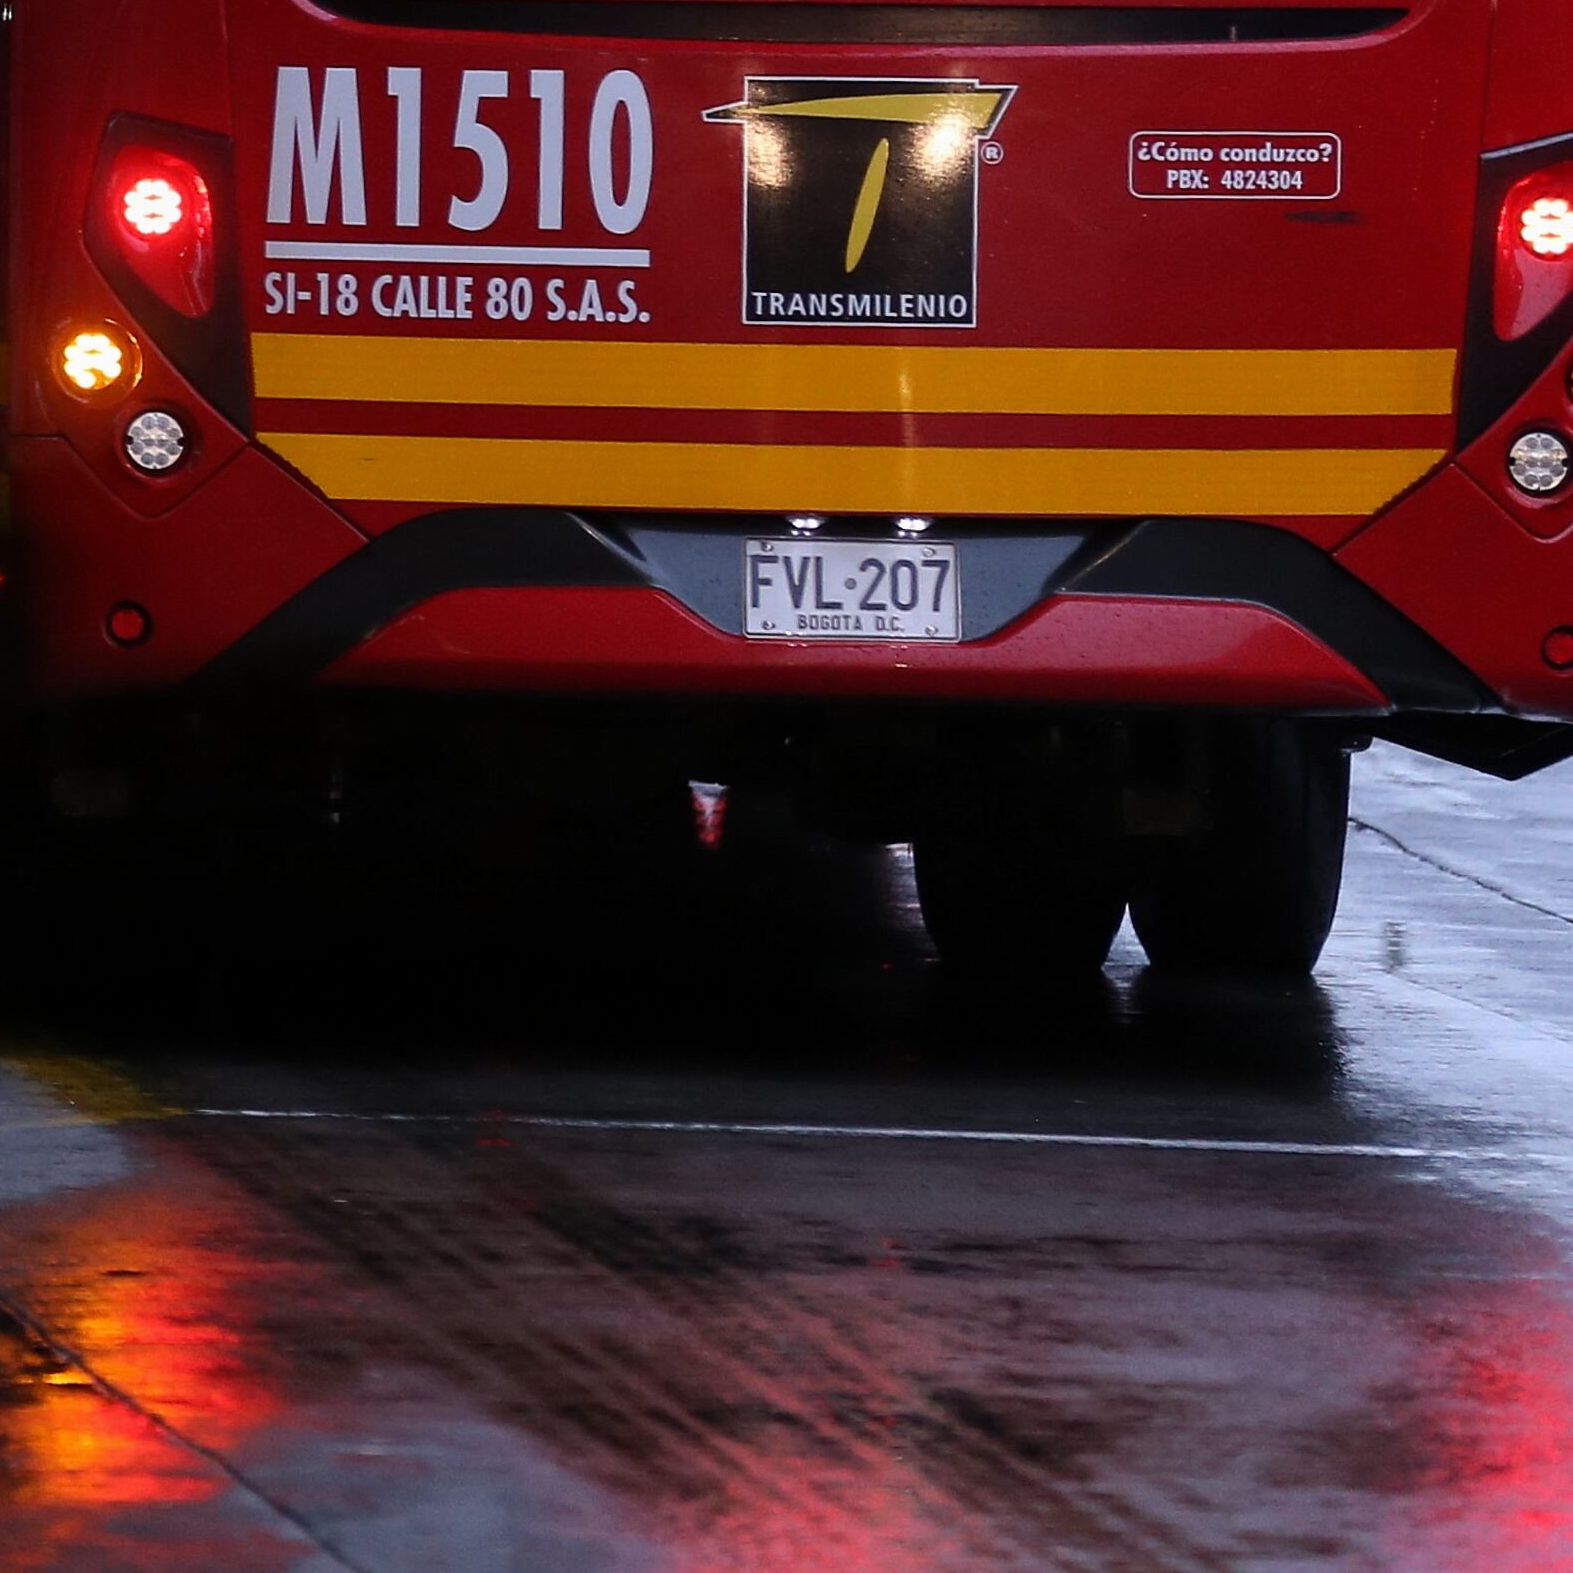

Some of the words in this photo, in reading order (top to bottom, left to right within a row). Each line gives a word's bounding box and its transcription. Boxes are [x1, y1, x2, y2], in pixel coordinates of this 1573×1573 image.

[266, 66, 653, 234] M1510
[1138, 141, 1213, 162] ¿Cómo
[1220, 141, 1333, 162] conduzco?
[1166, 169, 1209, 189] PBX:
[1220, 170, 1303, 190] 4824304
[265, 272, 358, 316] SI-18
[371, 274, 473, 320] CALLE
[486, 276, 533, 321] 80
[546, 279, 651, 323] S.A.S.
[751, 291, 968, 318] TRANSMILENIO
[797, 614, 864, 632] BOGOTA
[875, 615, 905, 632] D.C.
